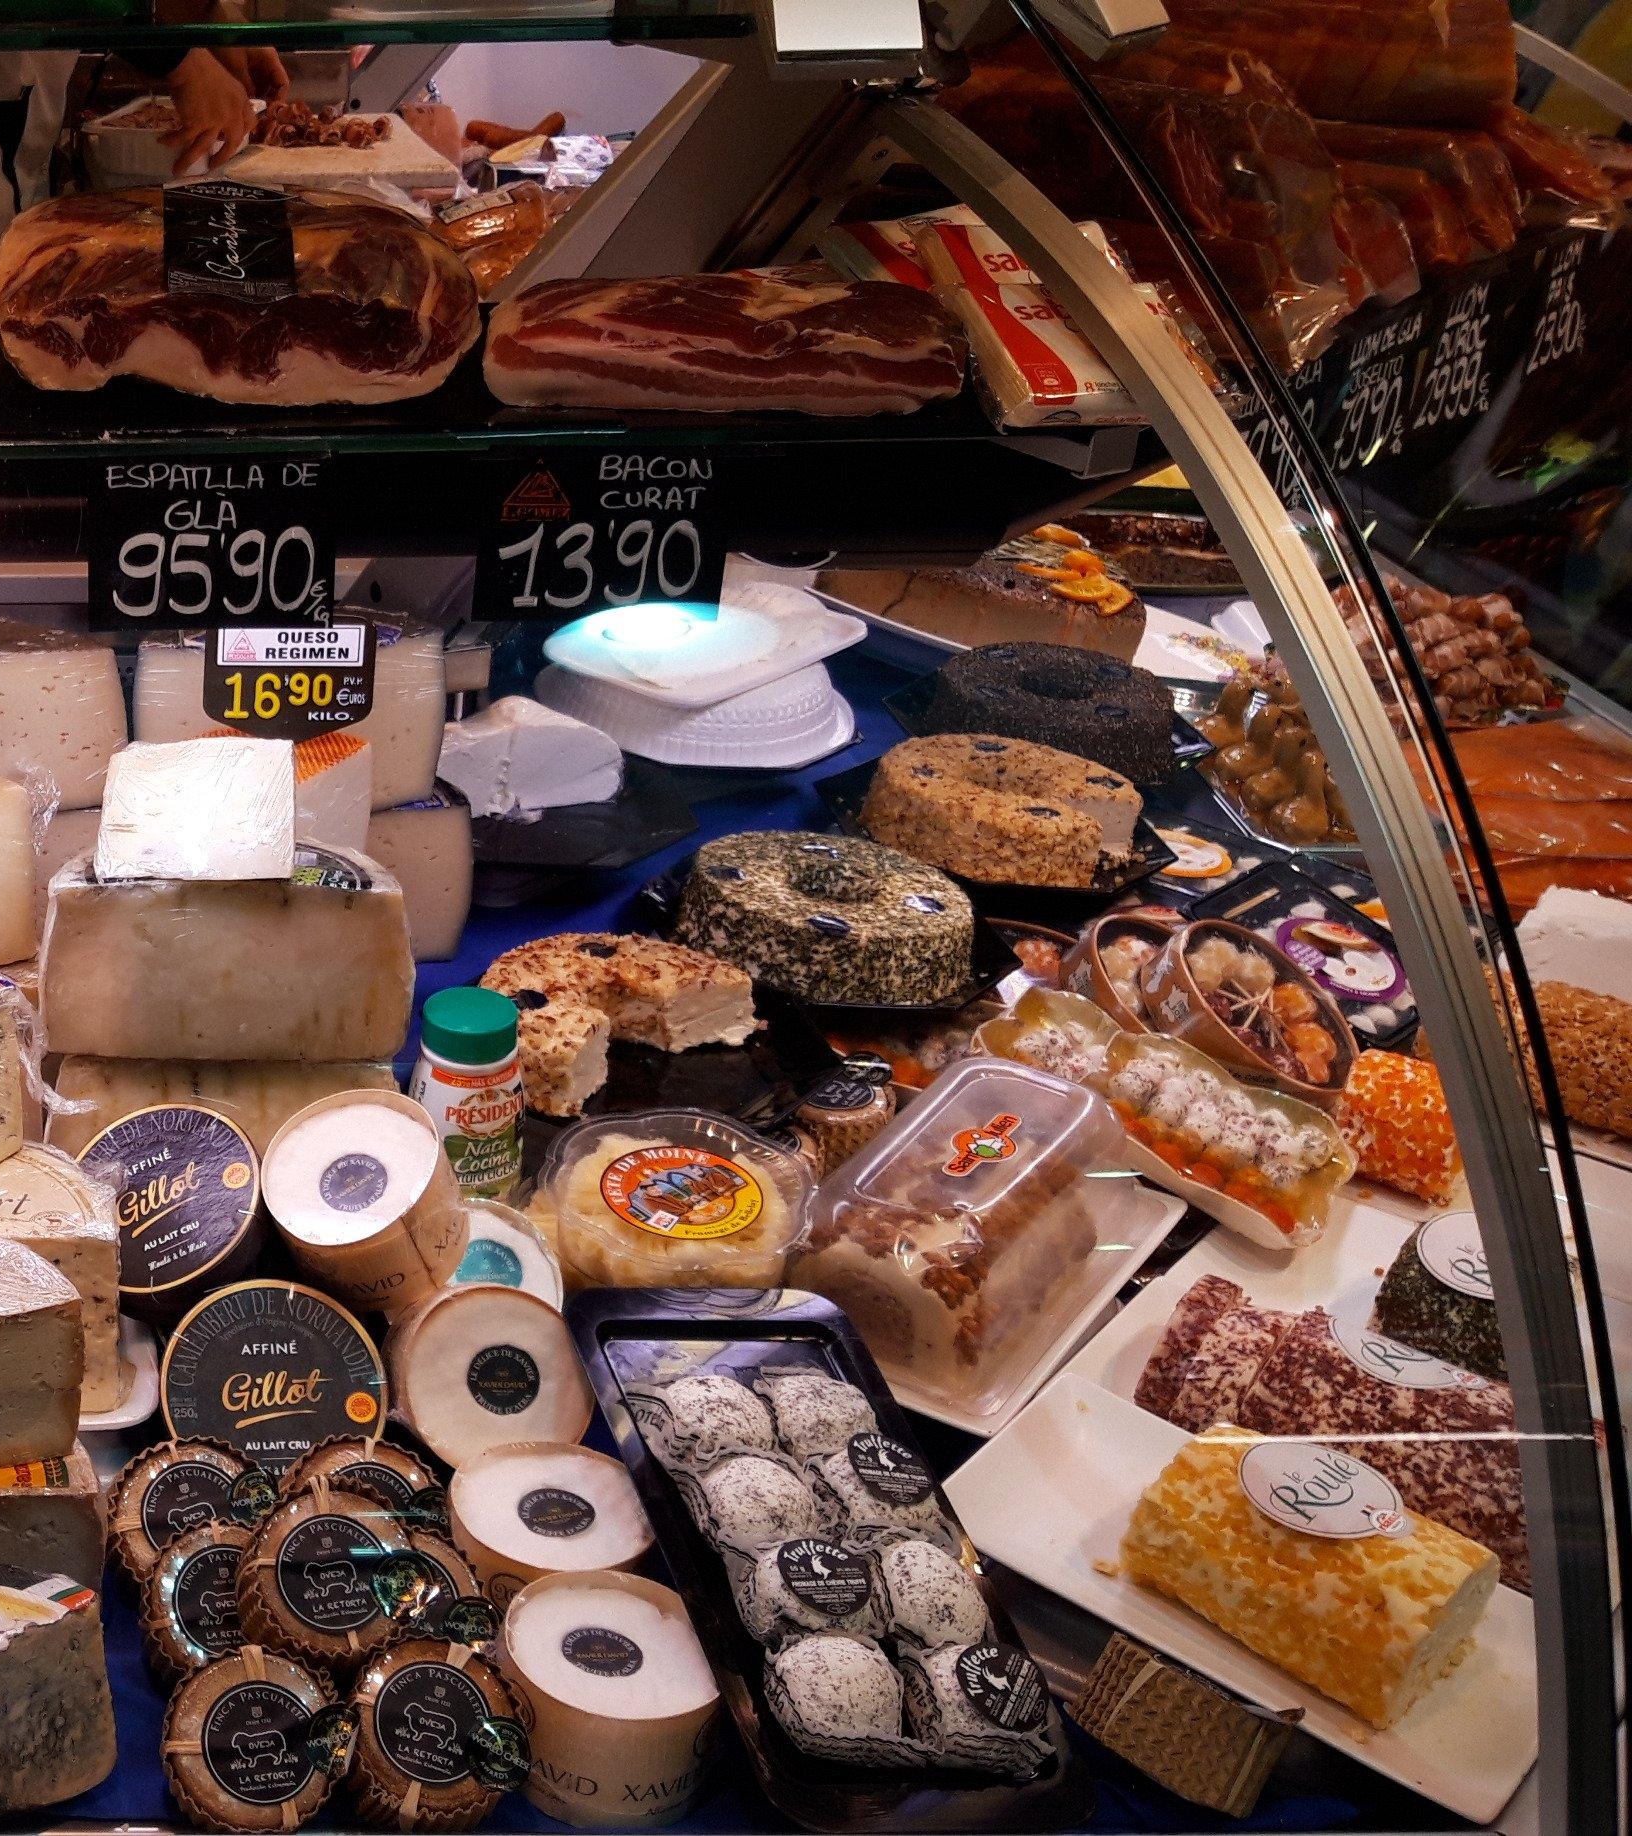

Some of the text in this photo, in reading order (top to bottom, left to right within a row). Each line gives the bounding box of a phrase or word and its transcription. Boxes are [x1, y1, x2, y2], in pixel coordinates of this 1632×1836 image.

[106, 463, 320, 491] ESPATLLA DE
[599, 454, 713, 482] BACON
[599, 486, 706, 511] CURAT
[112, 526, 315, 617] 95'90
[499, 519, 701, 609] 13'90
[277, 632, 339, 644] QUESO
[265, 647, 349, 659] REGIMEN
[224, 672, 333, 719] 16'90
[307, 712, 354, 721] KILO.
[445, 1093, 523, 1125] PRÉSIDENT
[464, 1138, 508, 1158] Nata
[616, 1154, 640, 1173] DE
[640, 1148, 710, 1164] MOINE
[124, 1148, 172, 1177] AFFINÉ
[454, 1152, 511, 1174] Cocina
[116, 1161, 206, 1227] Gillot
[143, 1220, 200, 1253] AU LAIT CRU
[168, 1290, 375, 1387] CAMEMBERT DE NORMANDIE
[240, 1340, 298, 1356] AFFINÉ
[221, 1368, 333, 1412] Gillot
[245, 1440, 311, 1451] AU LAIT CRU
[146, 1467, 229, 1514] FINCA PASCUALETE
[1269, 1453, 1361, 1526] Roulé
[282, 1534, 307, 1564] FINCA
[181, 1563, 204, 1591] FINCA
[320, 1570, 347, 1581] OVEJA
[312, 1598, 367, 1613] LA RETORTA
[966, 1646, 999, 1697] Truffette
[390, 1669, 486, 1721] FINCA PASCUALETE
[210, 1692, 306, 1731] FINCA PASCUALETE
[419, 1717, 446, 1731] OVEJA
[248, 1740, 276, 1750] OVEJA
[398, 1744, 410, 1754] LA
[413, 1749, 454, 1767] RETORTA
[239, 1771, 295, 1784] LA RETORTA
